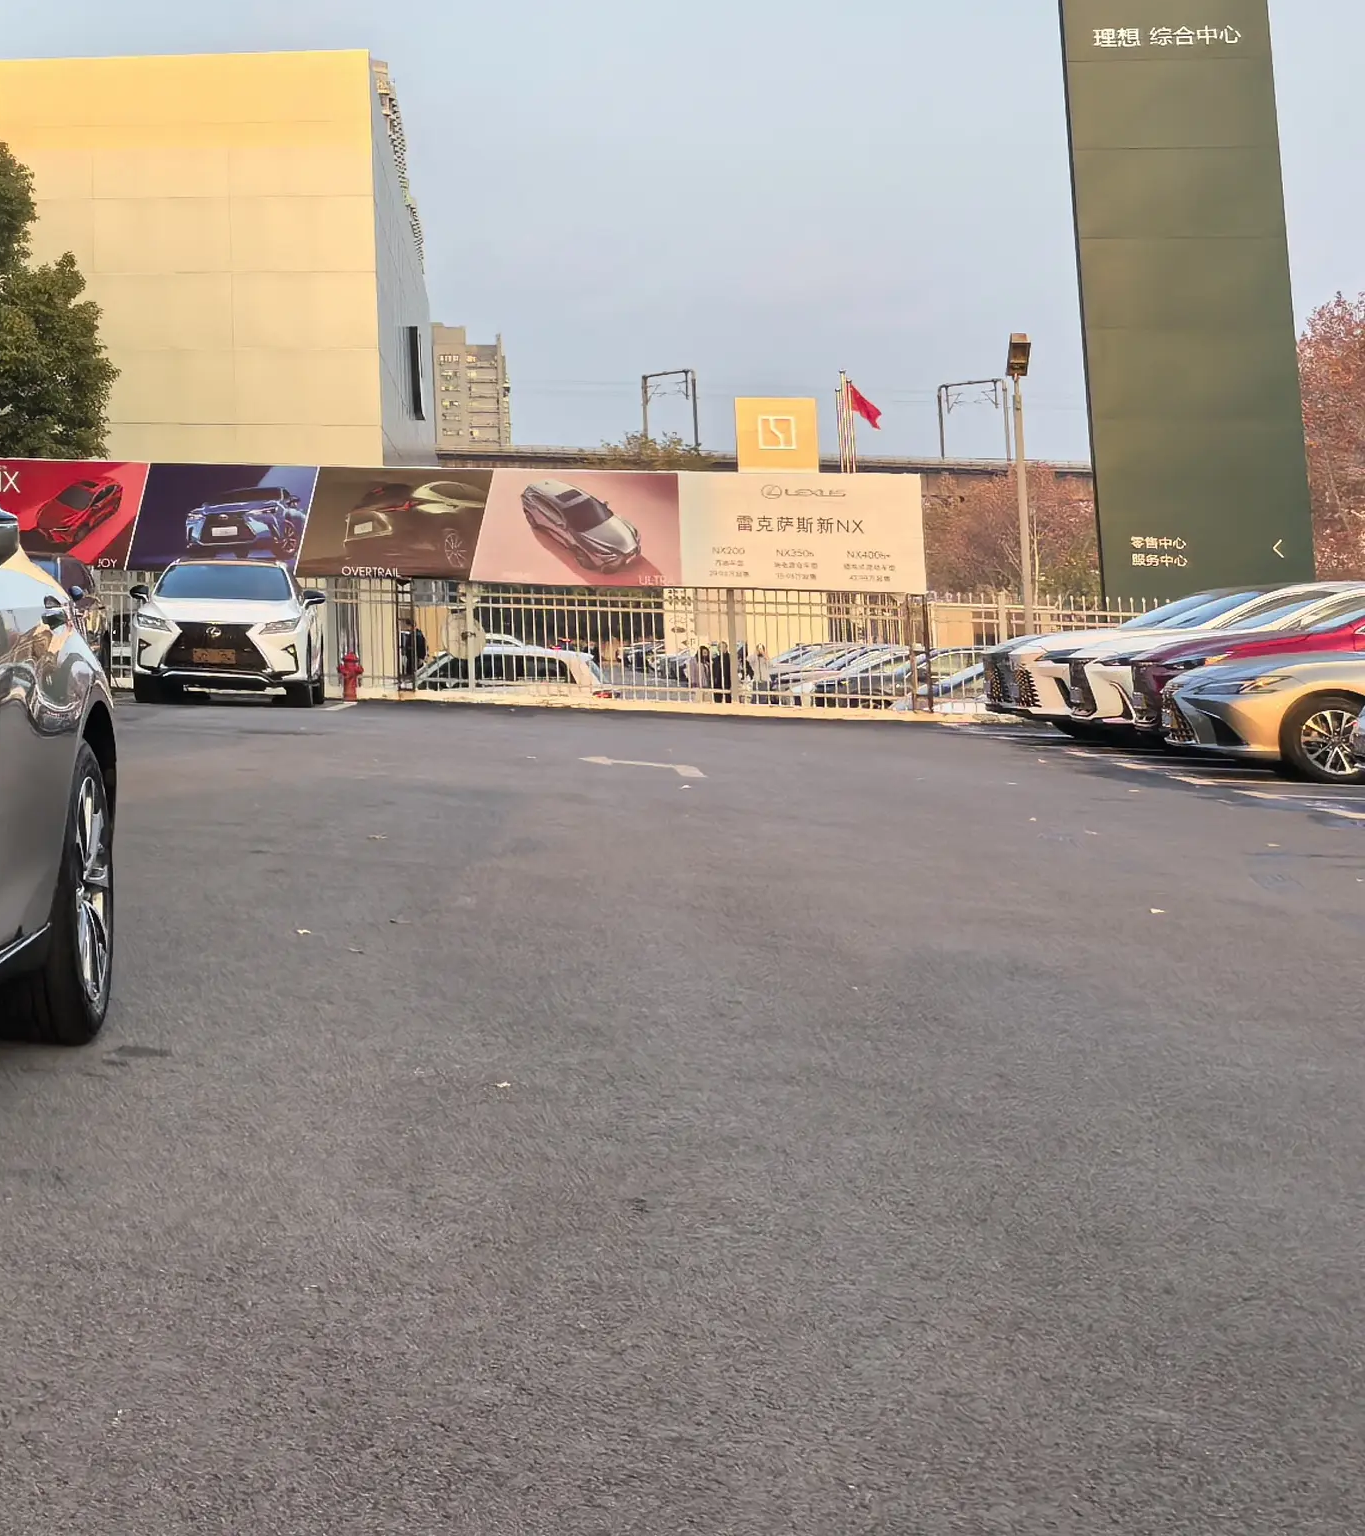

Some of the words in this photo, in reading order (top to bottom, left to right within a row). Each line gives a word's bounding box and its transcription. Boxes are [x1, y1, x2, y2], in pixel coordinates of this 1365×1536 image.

[1092, 26, 1142, 48] 理想
[1149, 24, 1242, 47] 综合中心
[784, 487, 847, 498] LEXUS
[735, 514, 865, 535] 雷克萨斯新NX
[1130, 536, 1187, 550] 零售中心
[97, 558, 118, 568] JOY
[1131, 553, 1188, 568] 服务中心
[341, 565, 402, 578] OVERTRAIL
